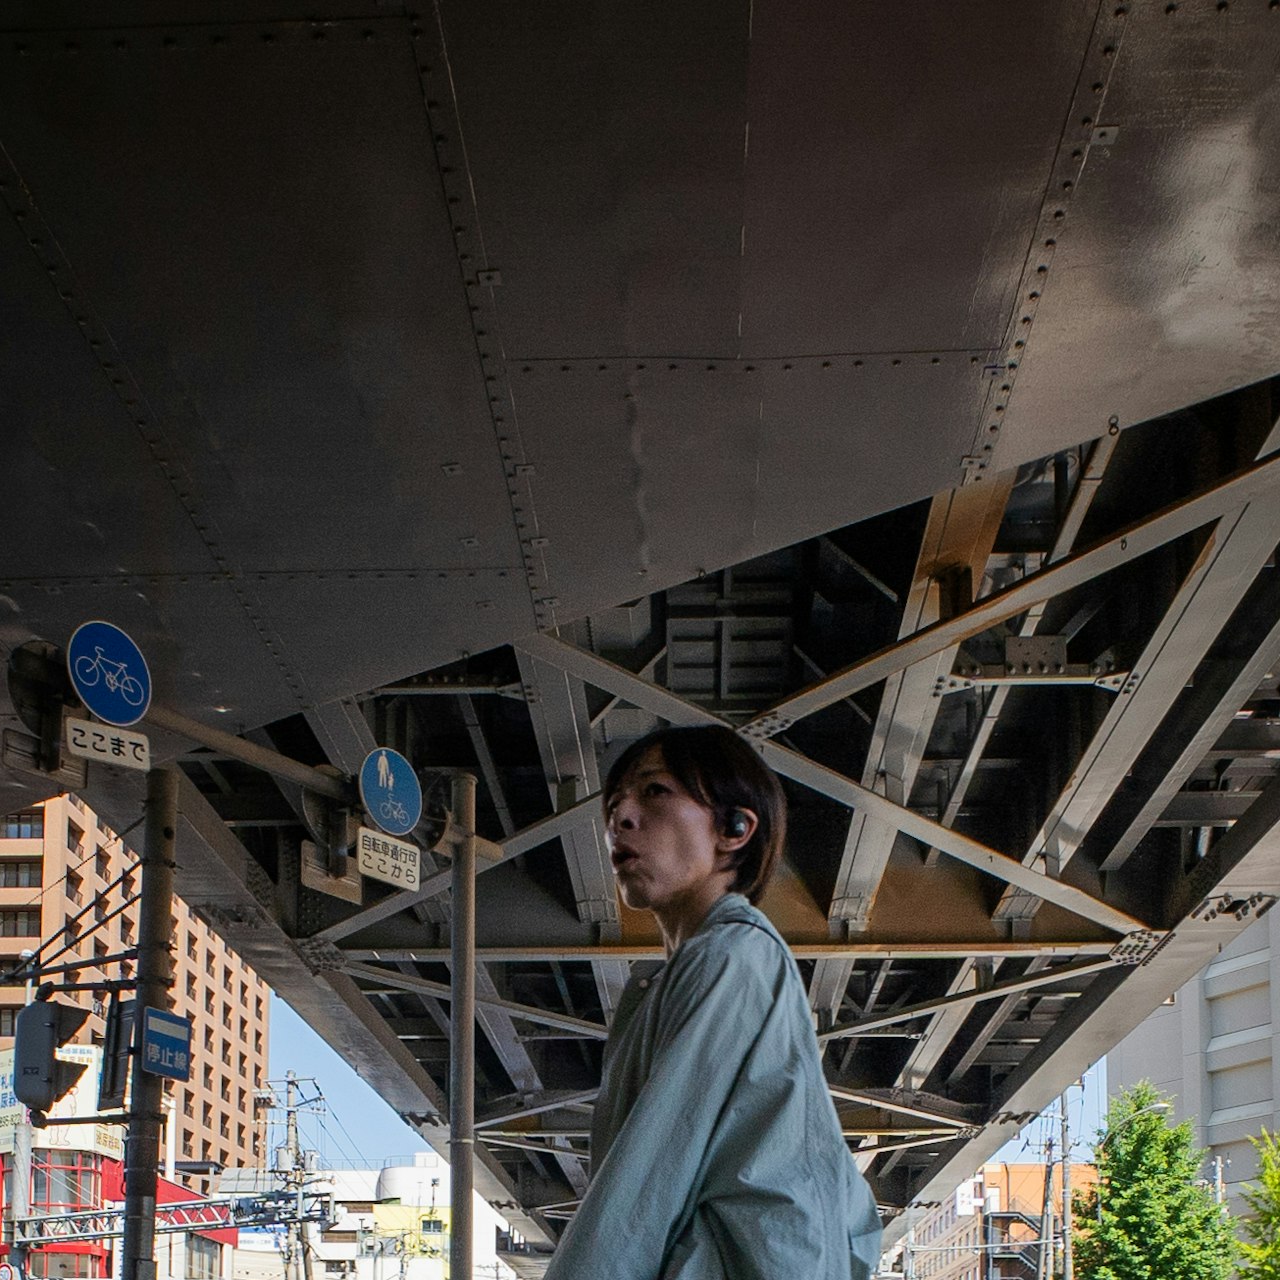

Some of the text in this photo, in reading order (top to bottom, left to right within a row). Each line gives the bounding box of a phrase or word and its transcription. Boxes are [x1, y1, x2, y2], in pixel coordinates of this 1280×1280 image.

[72, 727, 145, 762] ここまで
[362, 834, 417, 867] 自転車通行可
[363, 853, 416, 884] ここから
[147, 1042, 187, 1071] 停止線
[0, 1269, 10, 1280] 50
